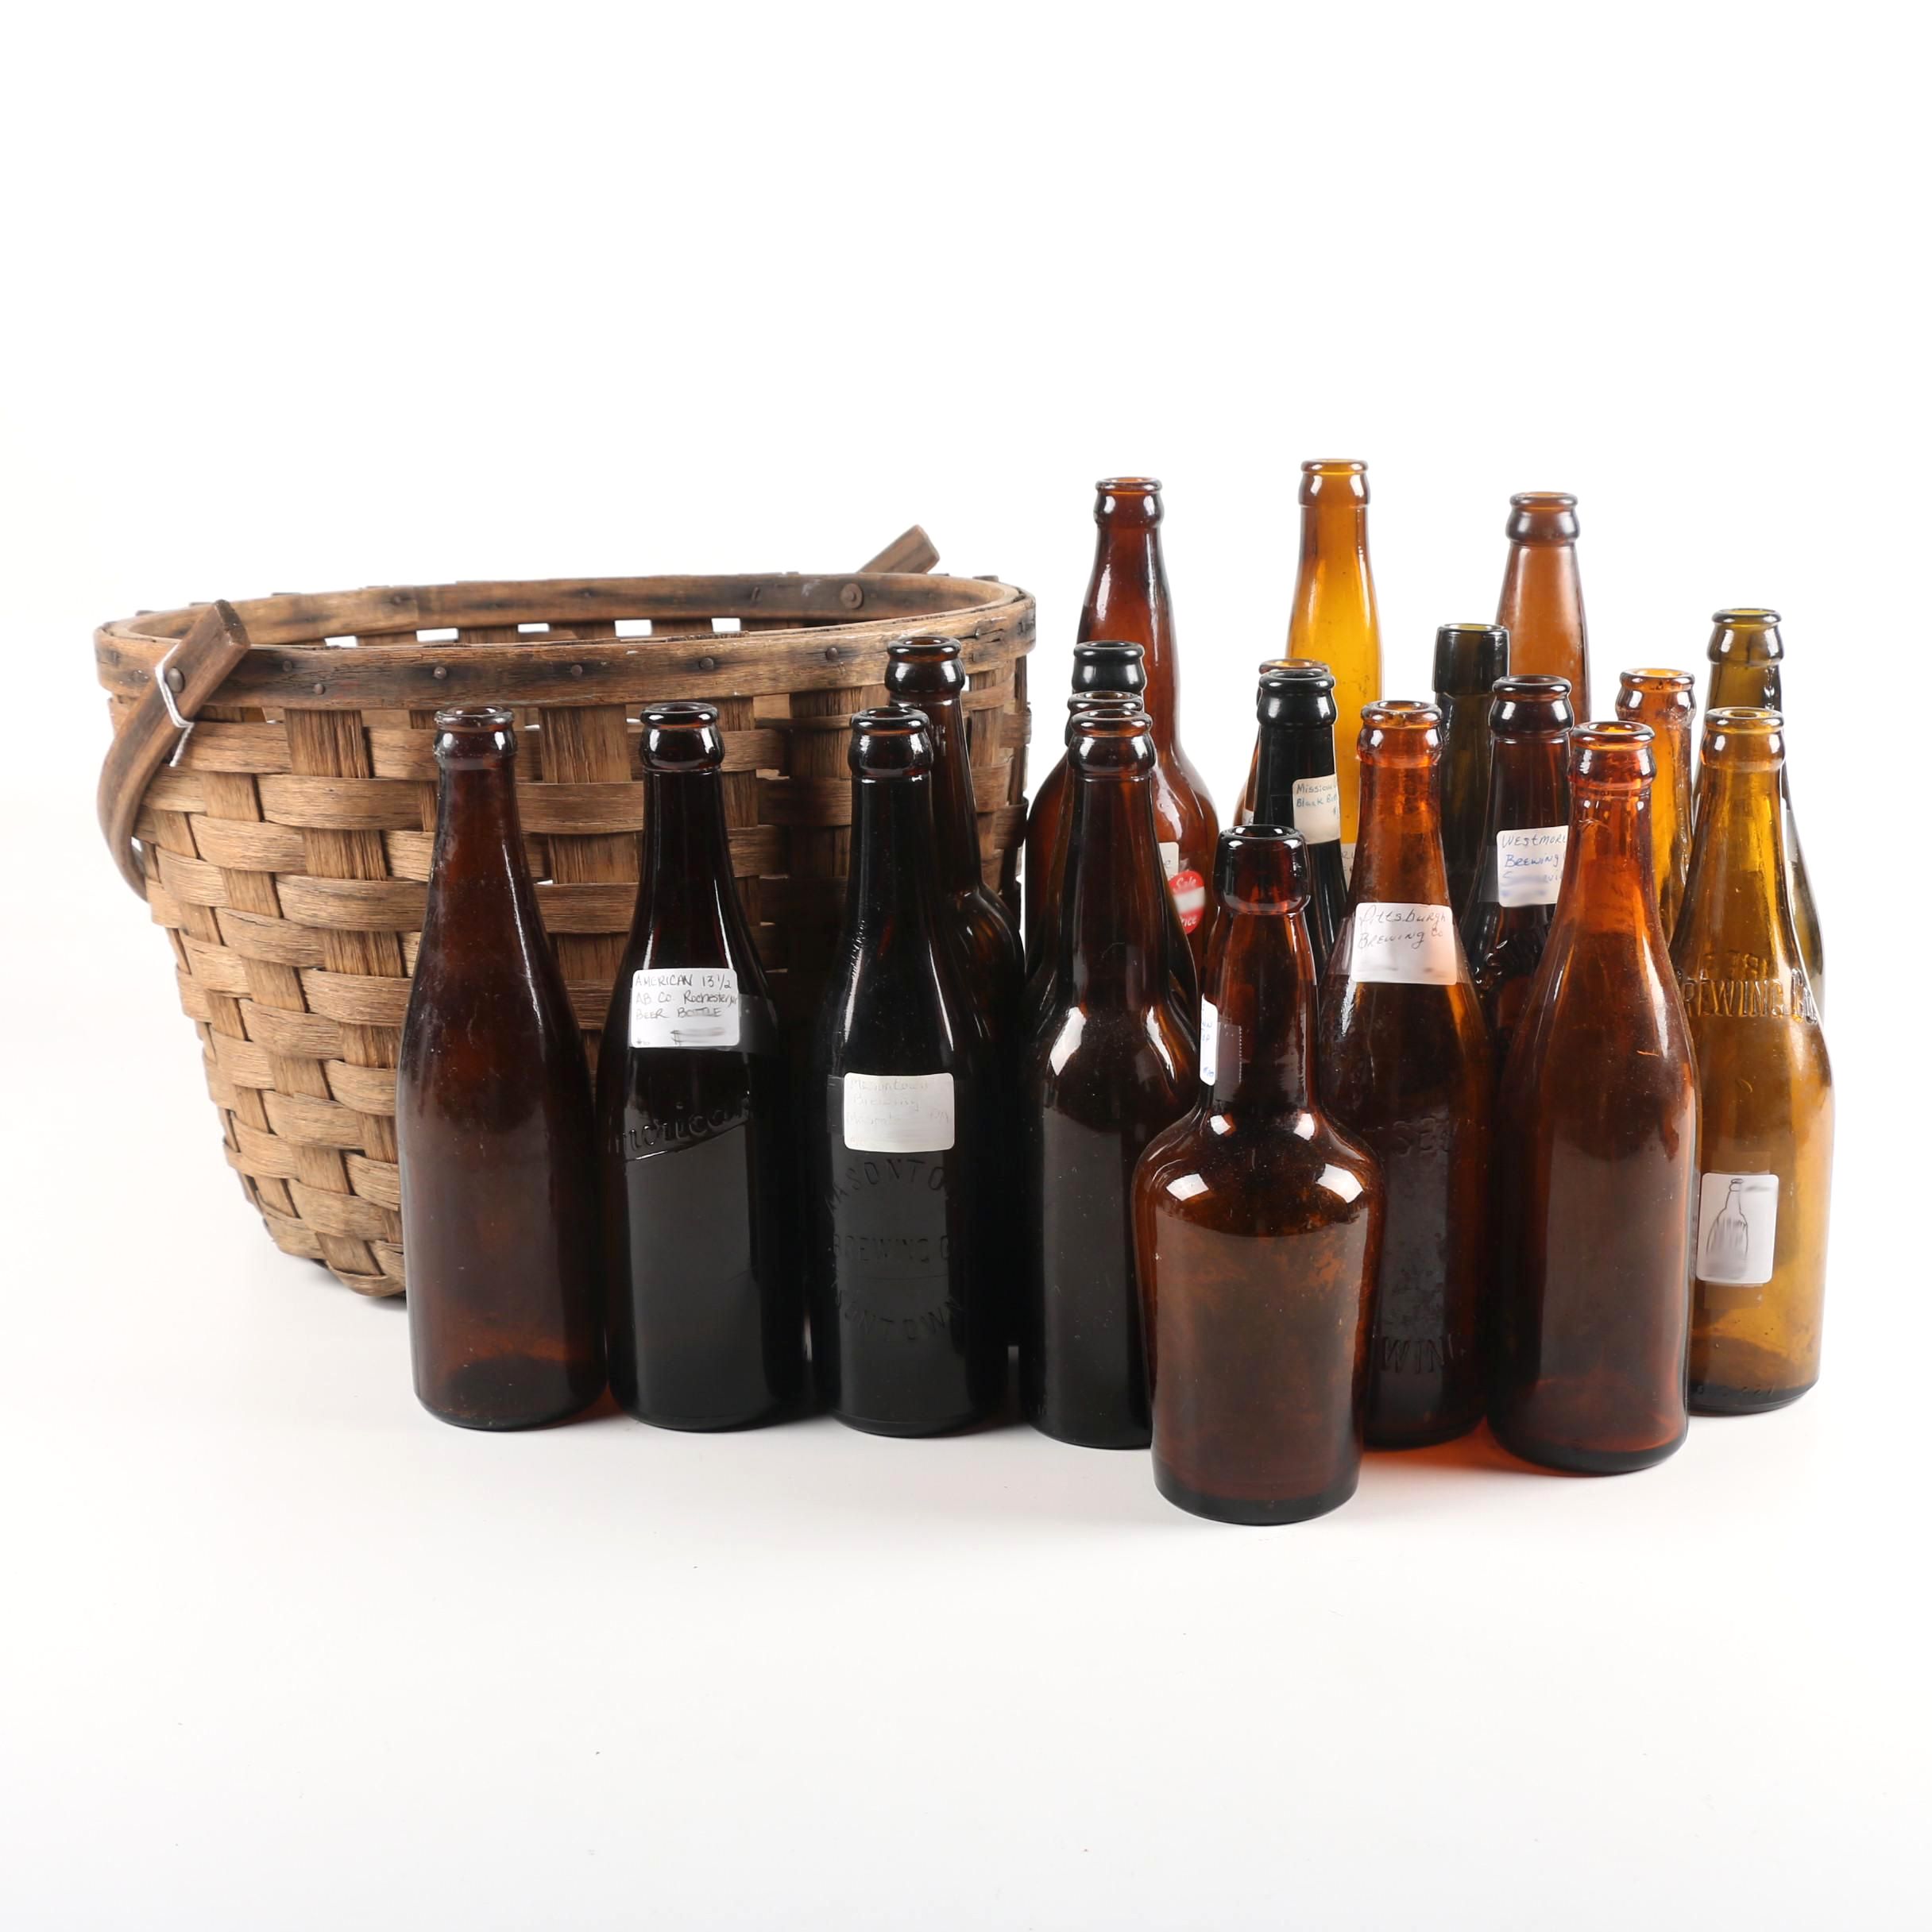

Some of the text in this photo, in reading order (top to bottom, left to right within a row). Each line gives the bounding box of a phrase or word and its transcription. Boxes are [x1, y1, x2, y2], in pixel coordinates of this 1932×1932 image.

[1296, 798, 1323, 808] Black
[1177, 875, 1196, 890] Sale
[636, 974, 693, 988] AMERICAN
[636, 1007, 723, 1021] BEER BOTTLE
